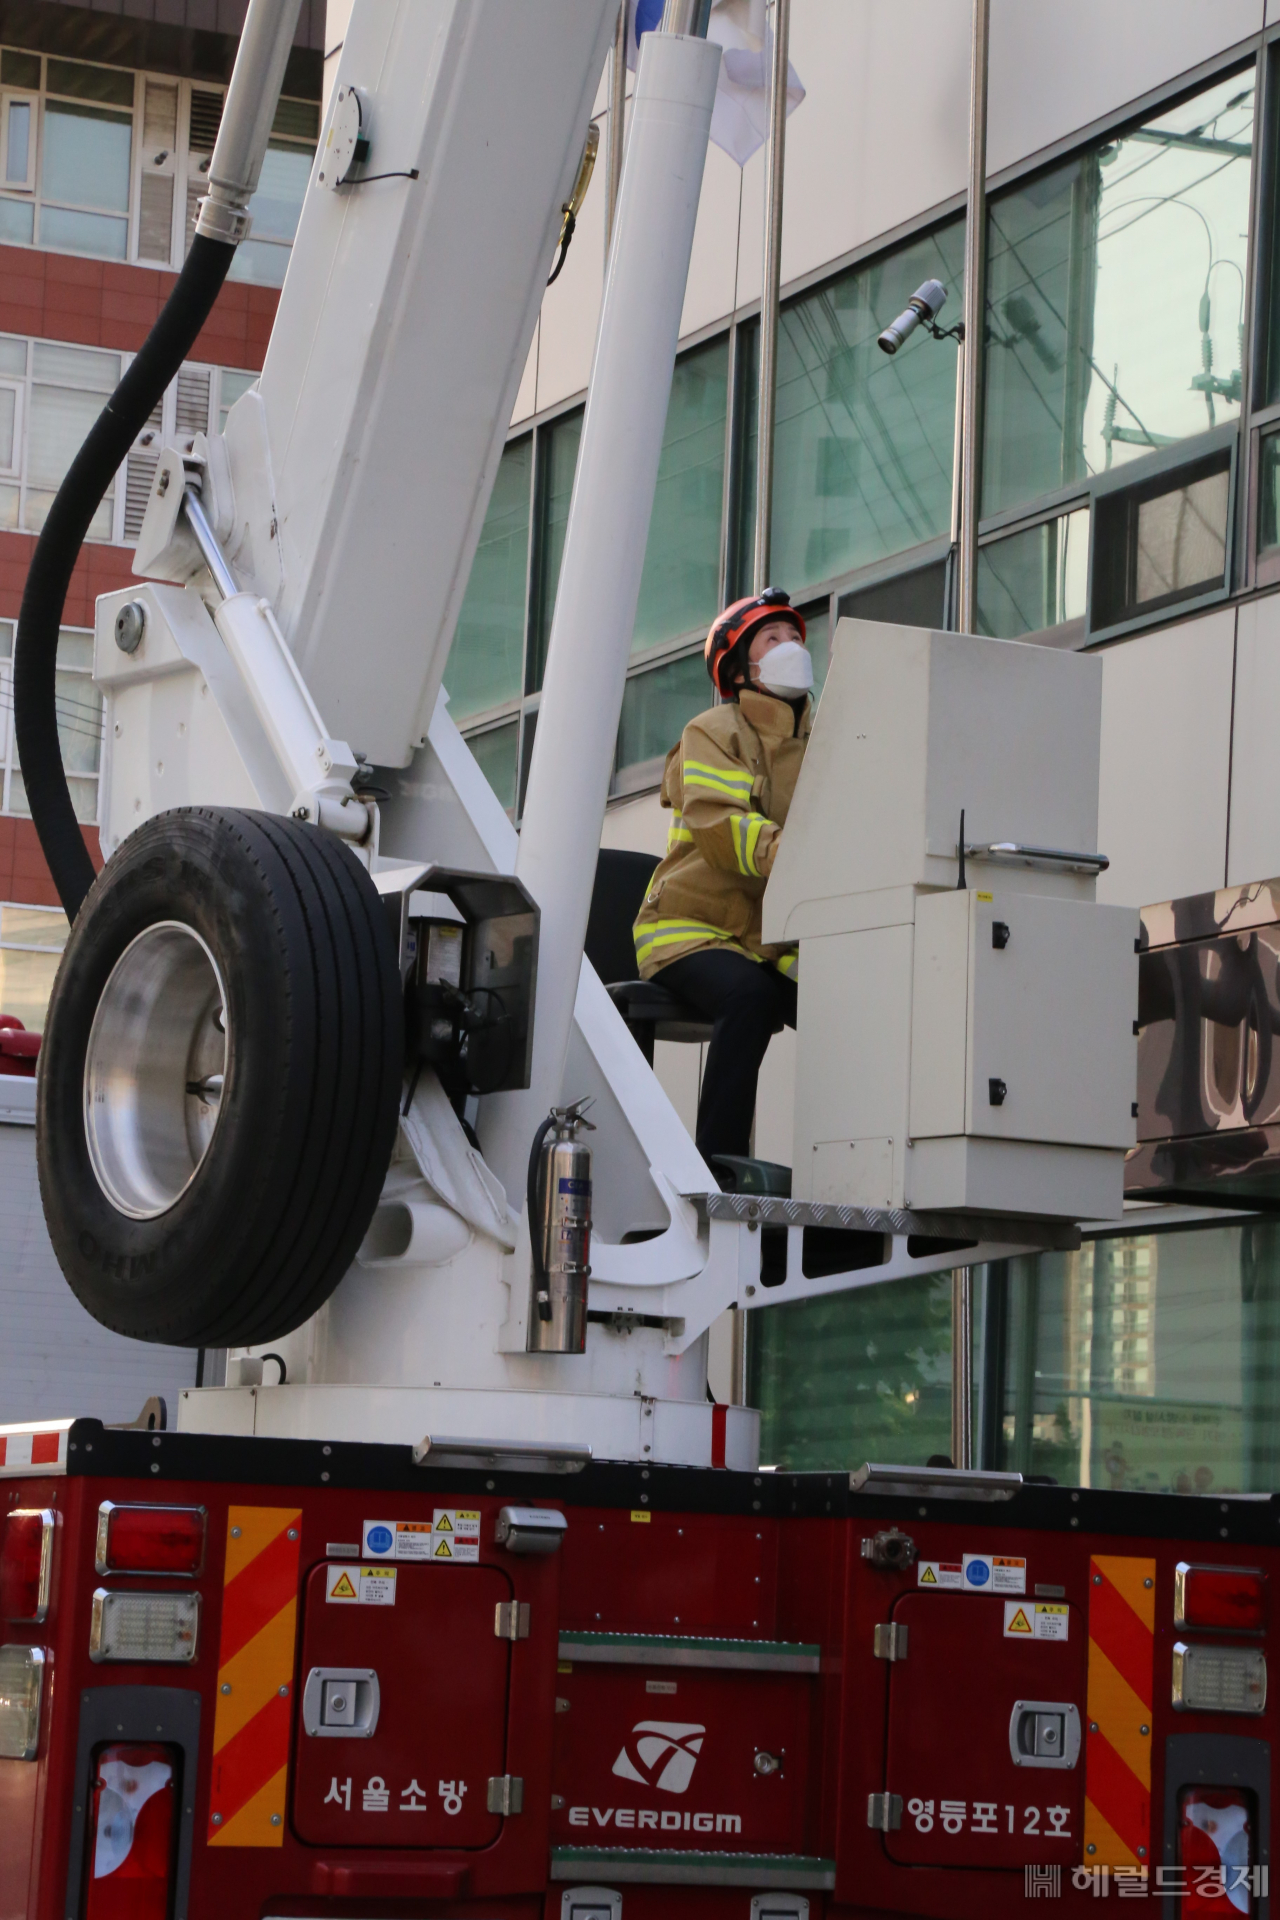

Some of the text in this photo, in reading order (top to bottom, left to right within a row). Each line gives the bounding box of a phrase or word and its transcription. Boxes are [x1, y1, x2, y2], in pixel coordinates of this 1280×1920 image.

[323, 1776, 468, 1815] 서울소방
[568, 1806, 742, 1834] EVERDIGM
[907, 1798, 1072, 1837] 영등포12호
